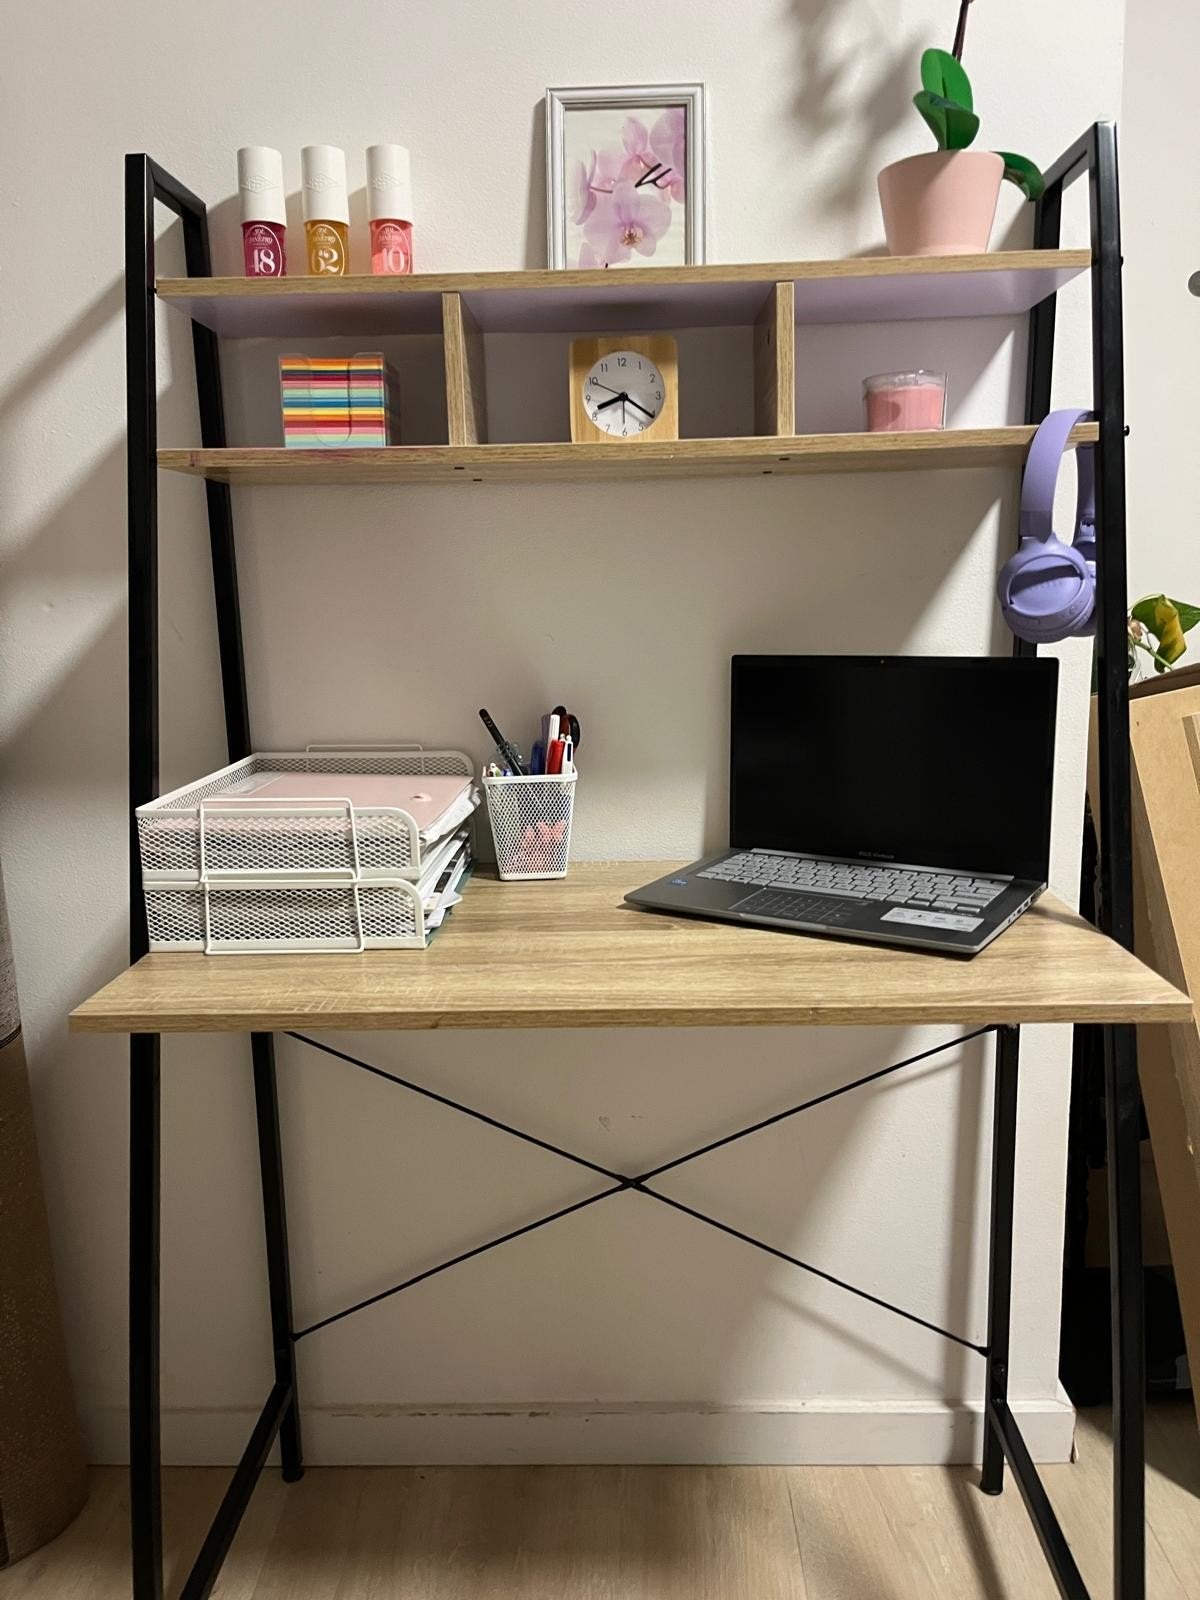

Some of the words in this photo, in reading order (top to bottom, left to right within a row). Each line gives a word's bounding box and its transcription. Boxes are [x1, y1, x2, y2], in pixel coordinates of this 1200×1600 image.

[617, 357, 627, 367] 12
[638, 361, 642, 370] 1
[600, 363, 608, 373] 11
[588, 376, 599, 385] 10
[649, 373, 656, 383] 2
[585, 394, 591, 403] 9
[655, 391, 662, 401] 3
[592, 412, 598, 422] 8
[605, 424, 611, 433] 7
[622, 426, 628, 437] 6
